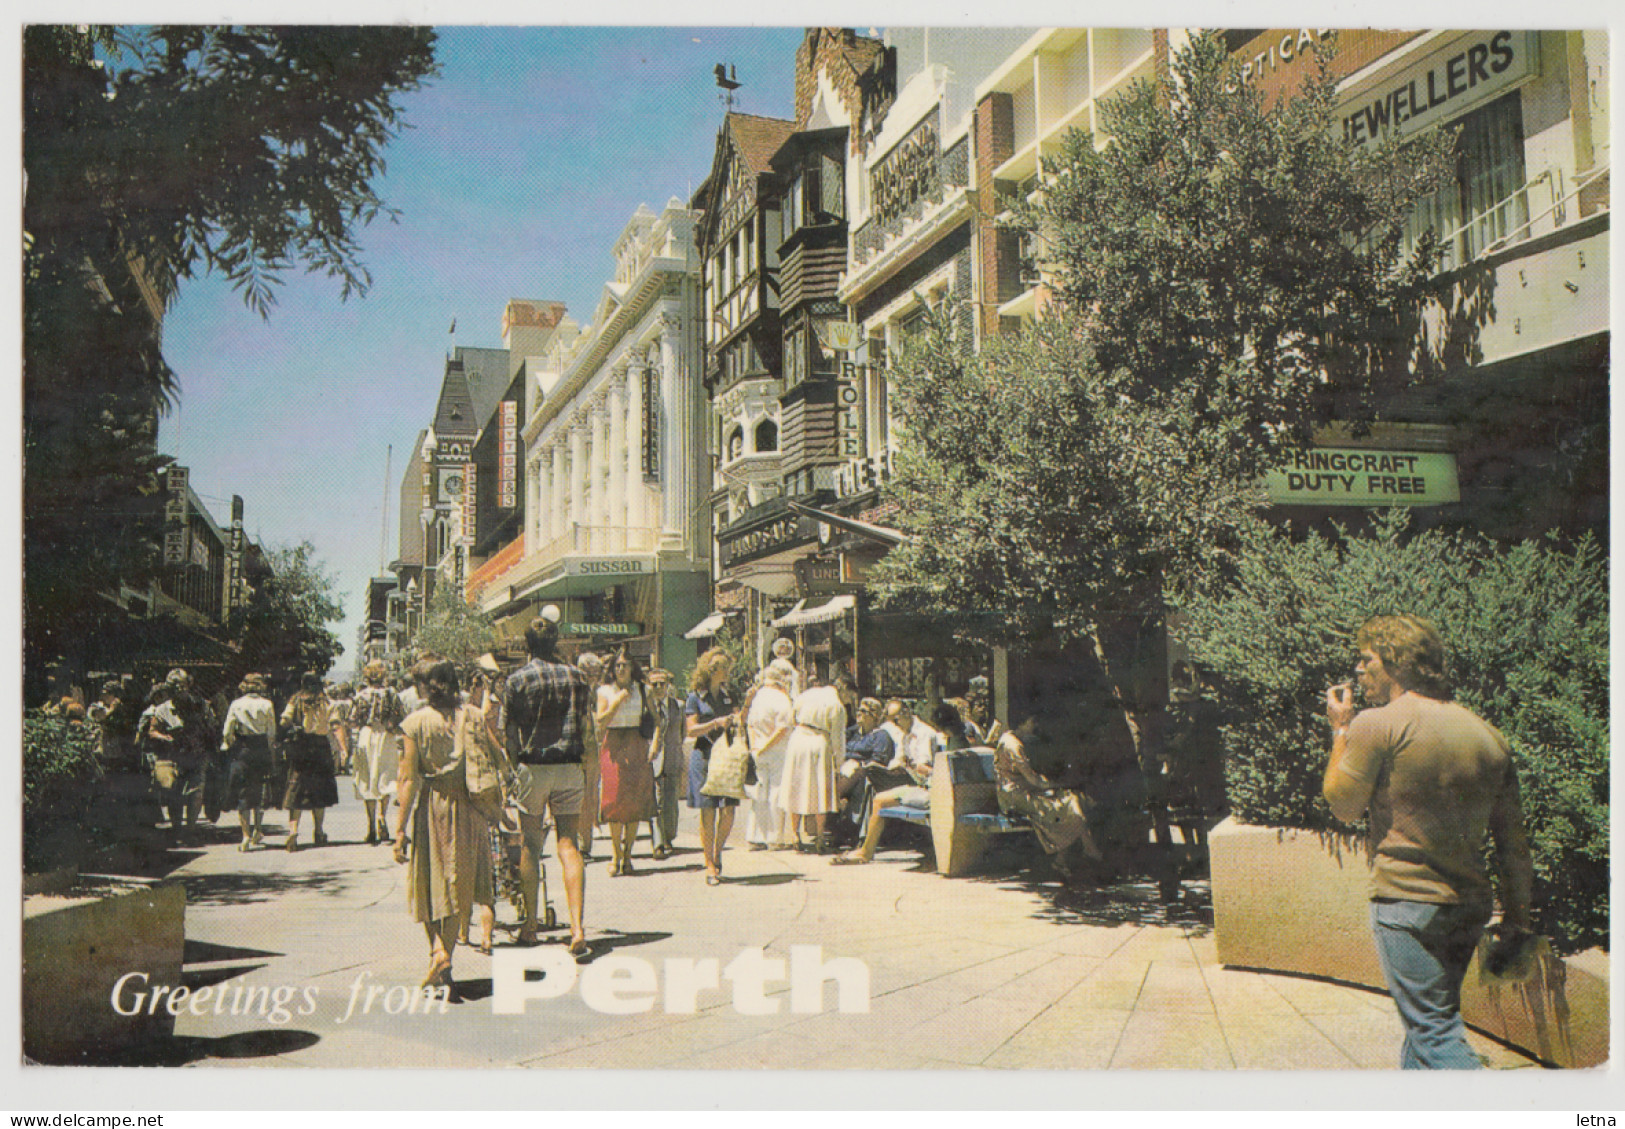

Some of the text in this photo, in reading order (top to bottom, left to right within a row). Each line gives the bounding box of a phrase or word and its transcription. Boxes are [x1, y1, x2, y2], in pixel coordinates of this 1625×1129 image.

[1343, 30, 1514, 146] JEWELLERS
[1294, 452, 1418, 473] RINGCRAFT
[1287, 473, 1426, 494] DUTY FREE
[580, 560, 642, 574] sussan
[570, 623, 629, 634] sussan
